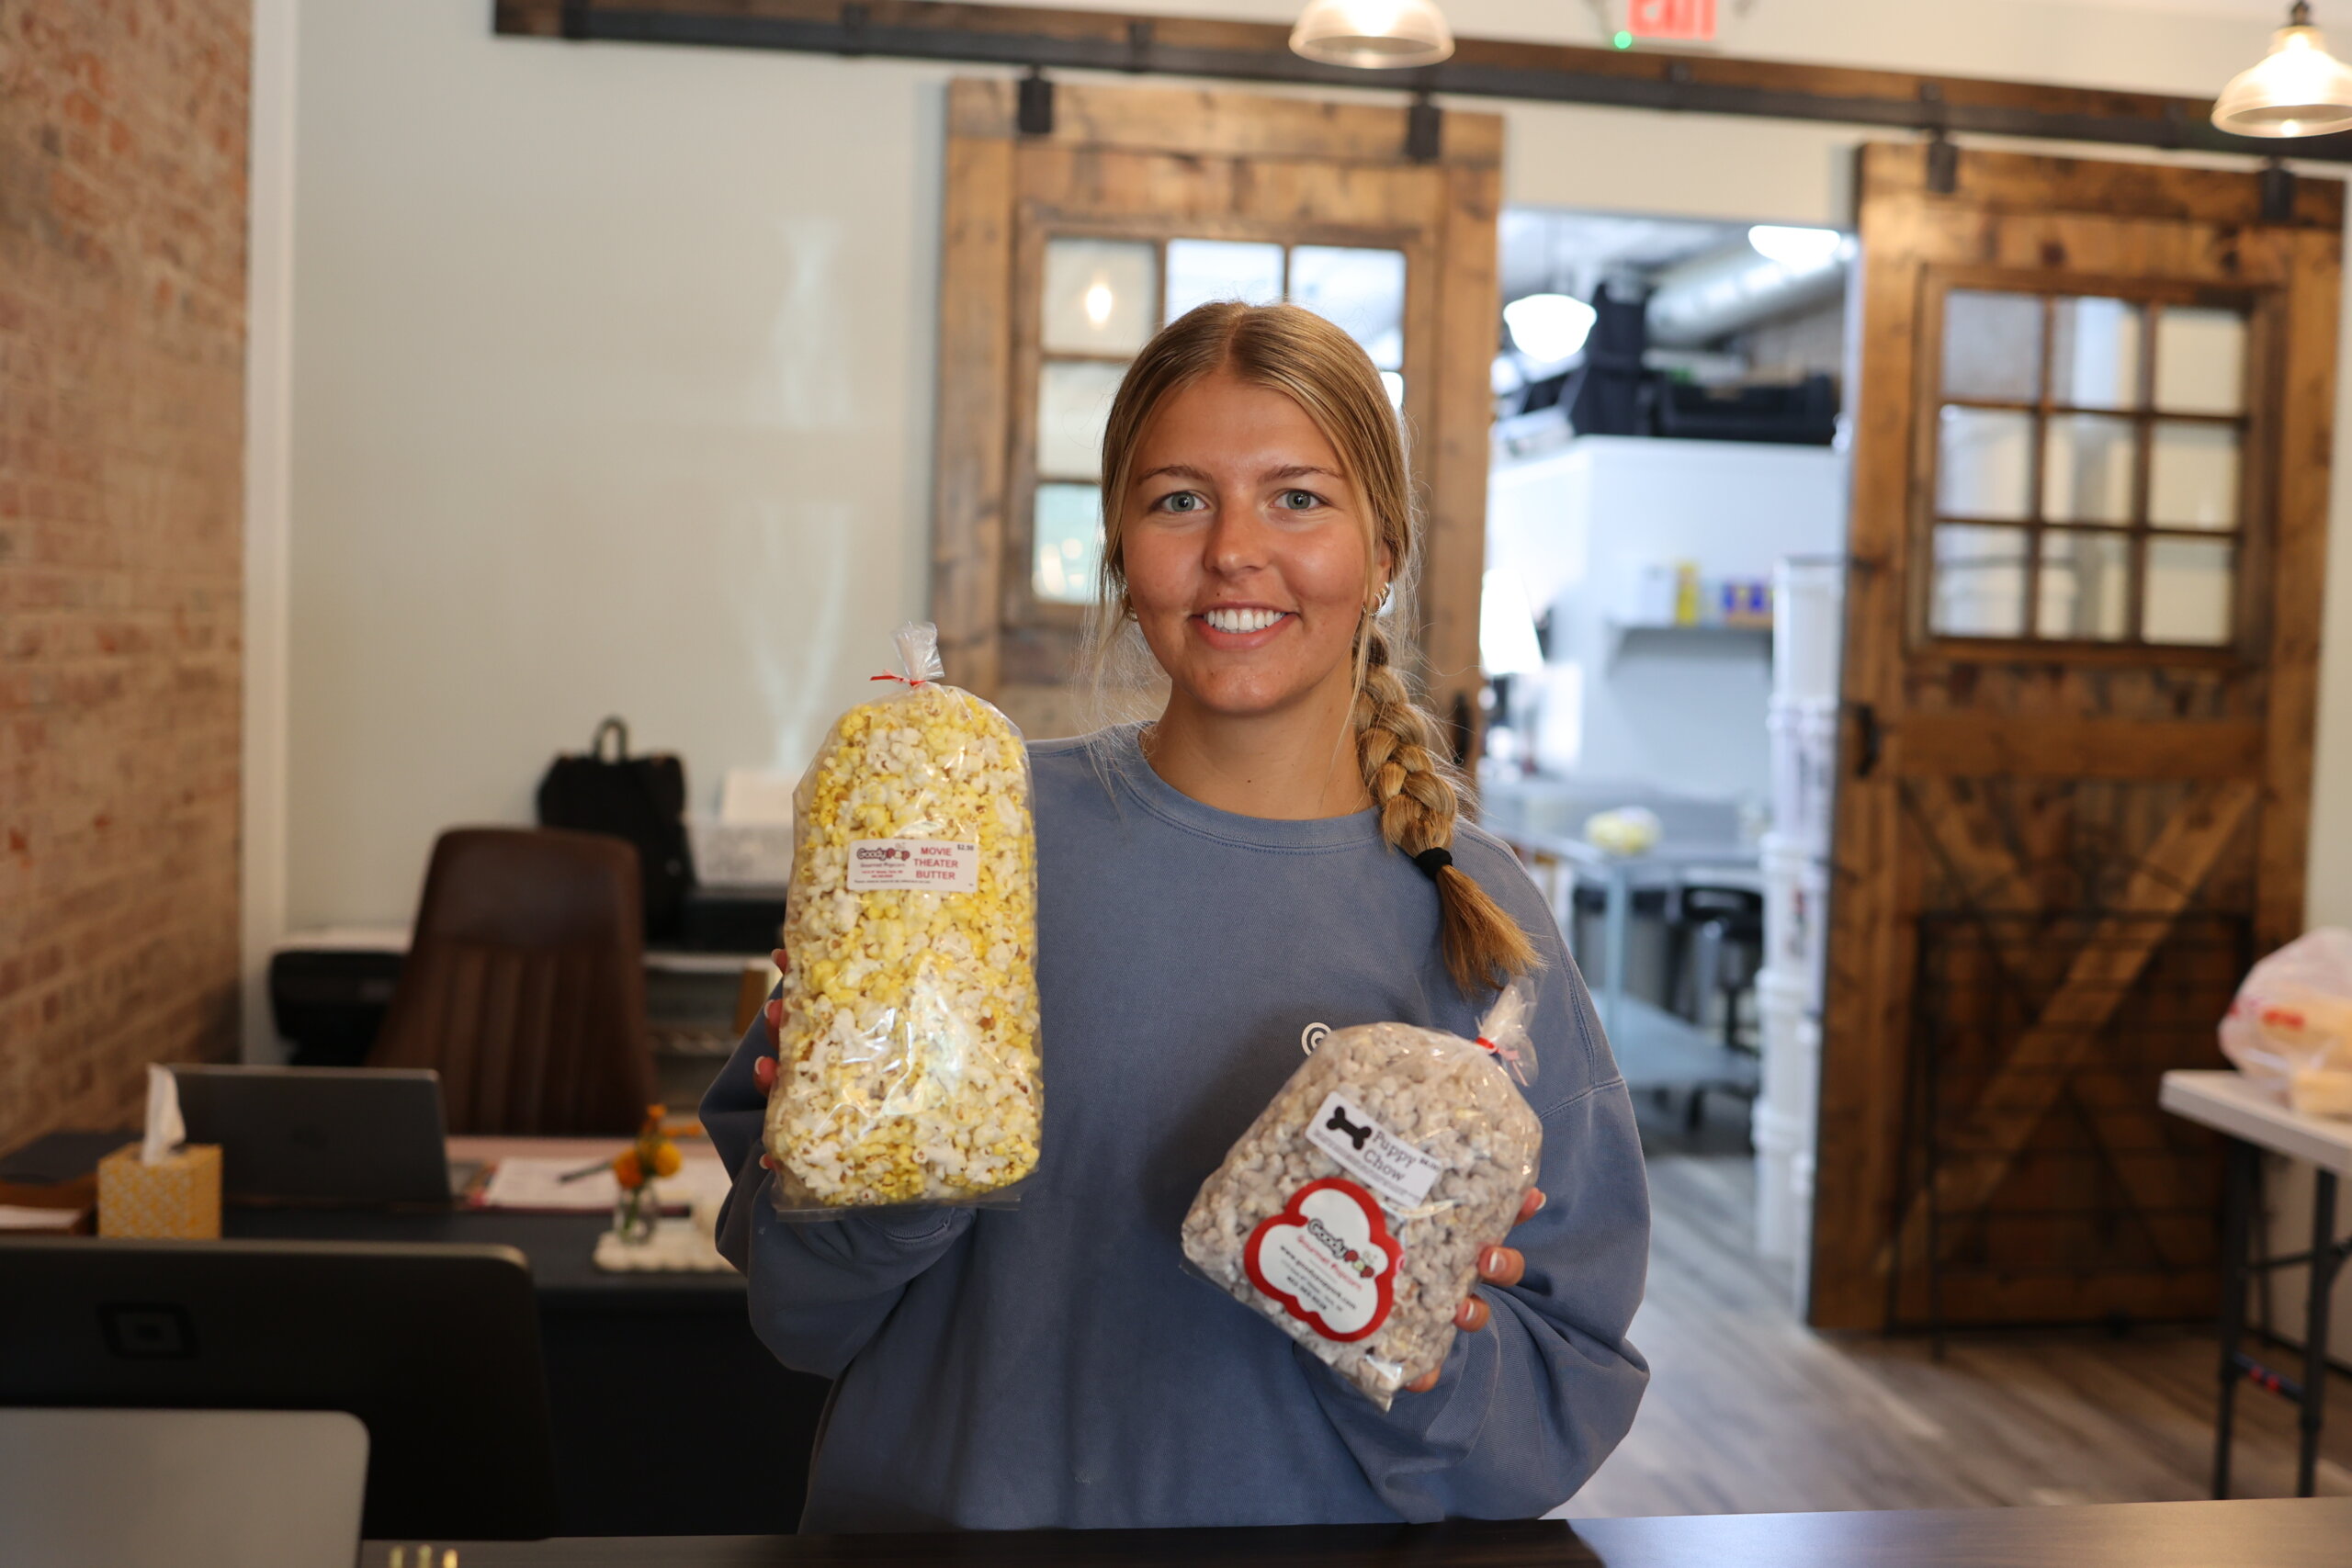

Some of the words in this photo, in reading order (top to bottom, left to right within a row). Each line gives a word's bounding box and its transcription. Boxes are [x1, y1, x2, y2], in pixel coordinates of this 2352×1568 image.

[1626, 0, 1716, 40] EXIT
[920, 847, 953, 856] MOVIE
[913, 858, 959, 868] THEATER
[915, 870, 956, 880] BUTTER
[1373, 1130, 1416, 1168] Puppy
[1363, 1148, 1406, 1181] Chow
